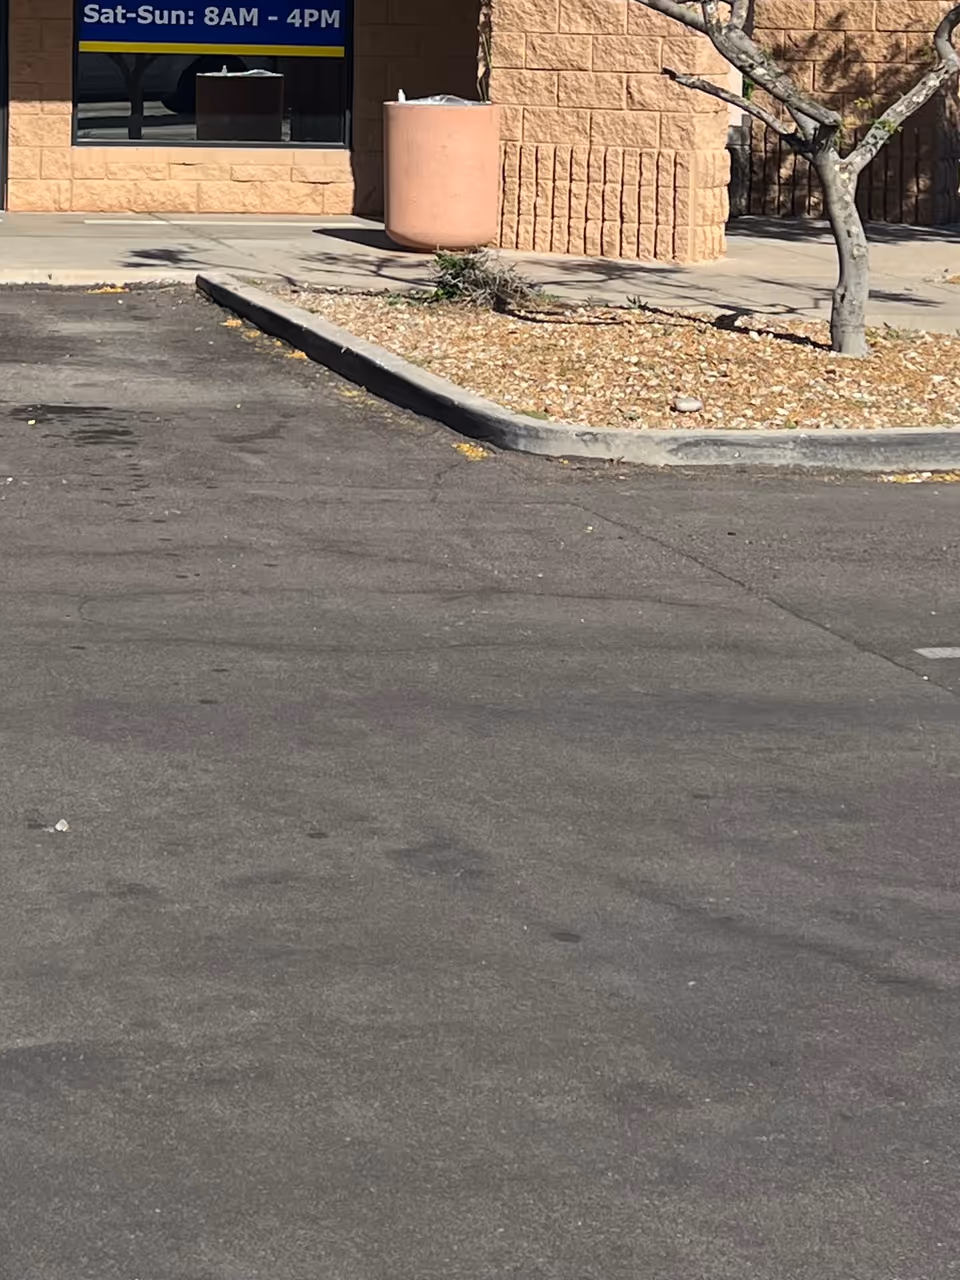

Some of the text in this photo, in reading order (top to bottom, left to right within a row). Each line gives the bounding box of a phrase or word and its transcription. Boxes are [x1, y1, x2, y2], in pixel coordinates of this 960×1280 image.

[83, 4, 195, 25] Sat-Sun:
[203, 6, 259, 27] 8AM
[286, 9, 341, 28] 4PM
